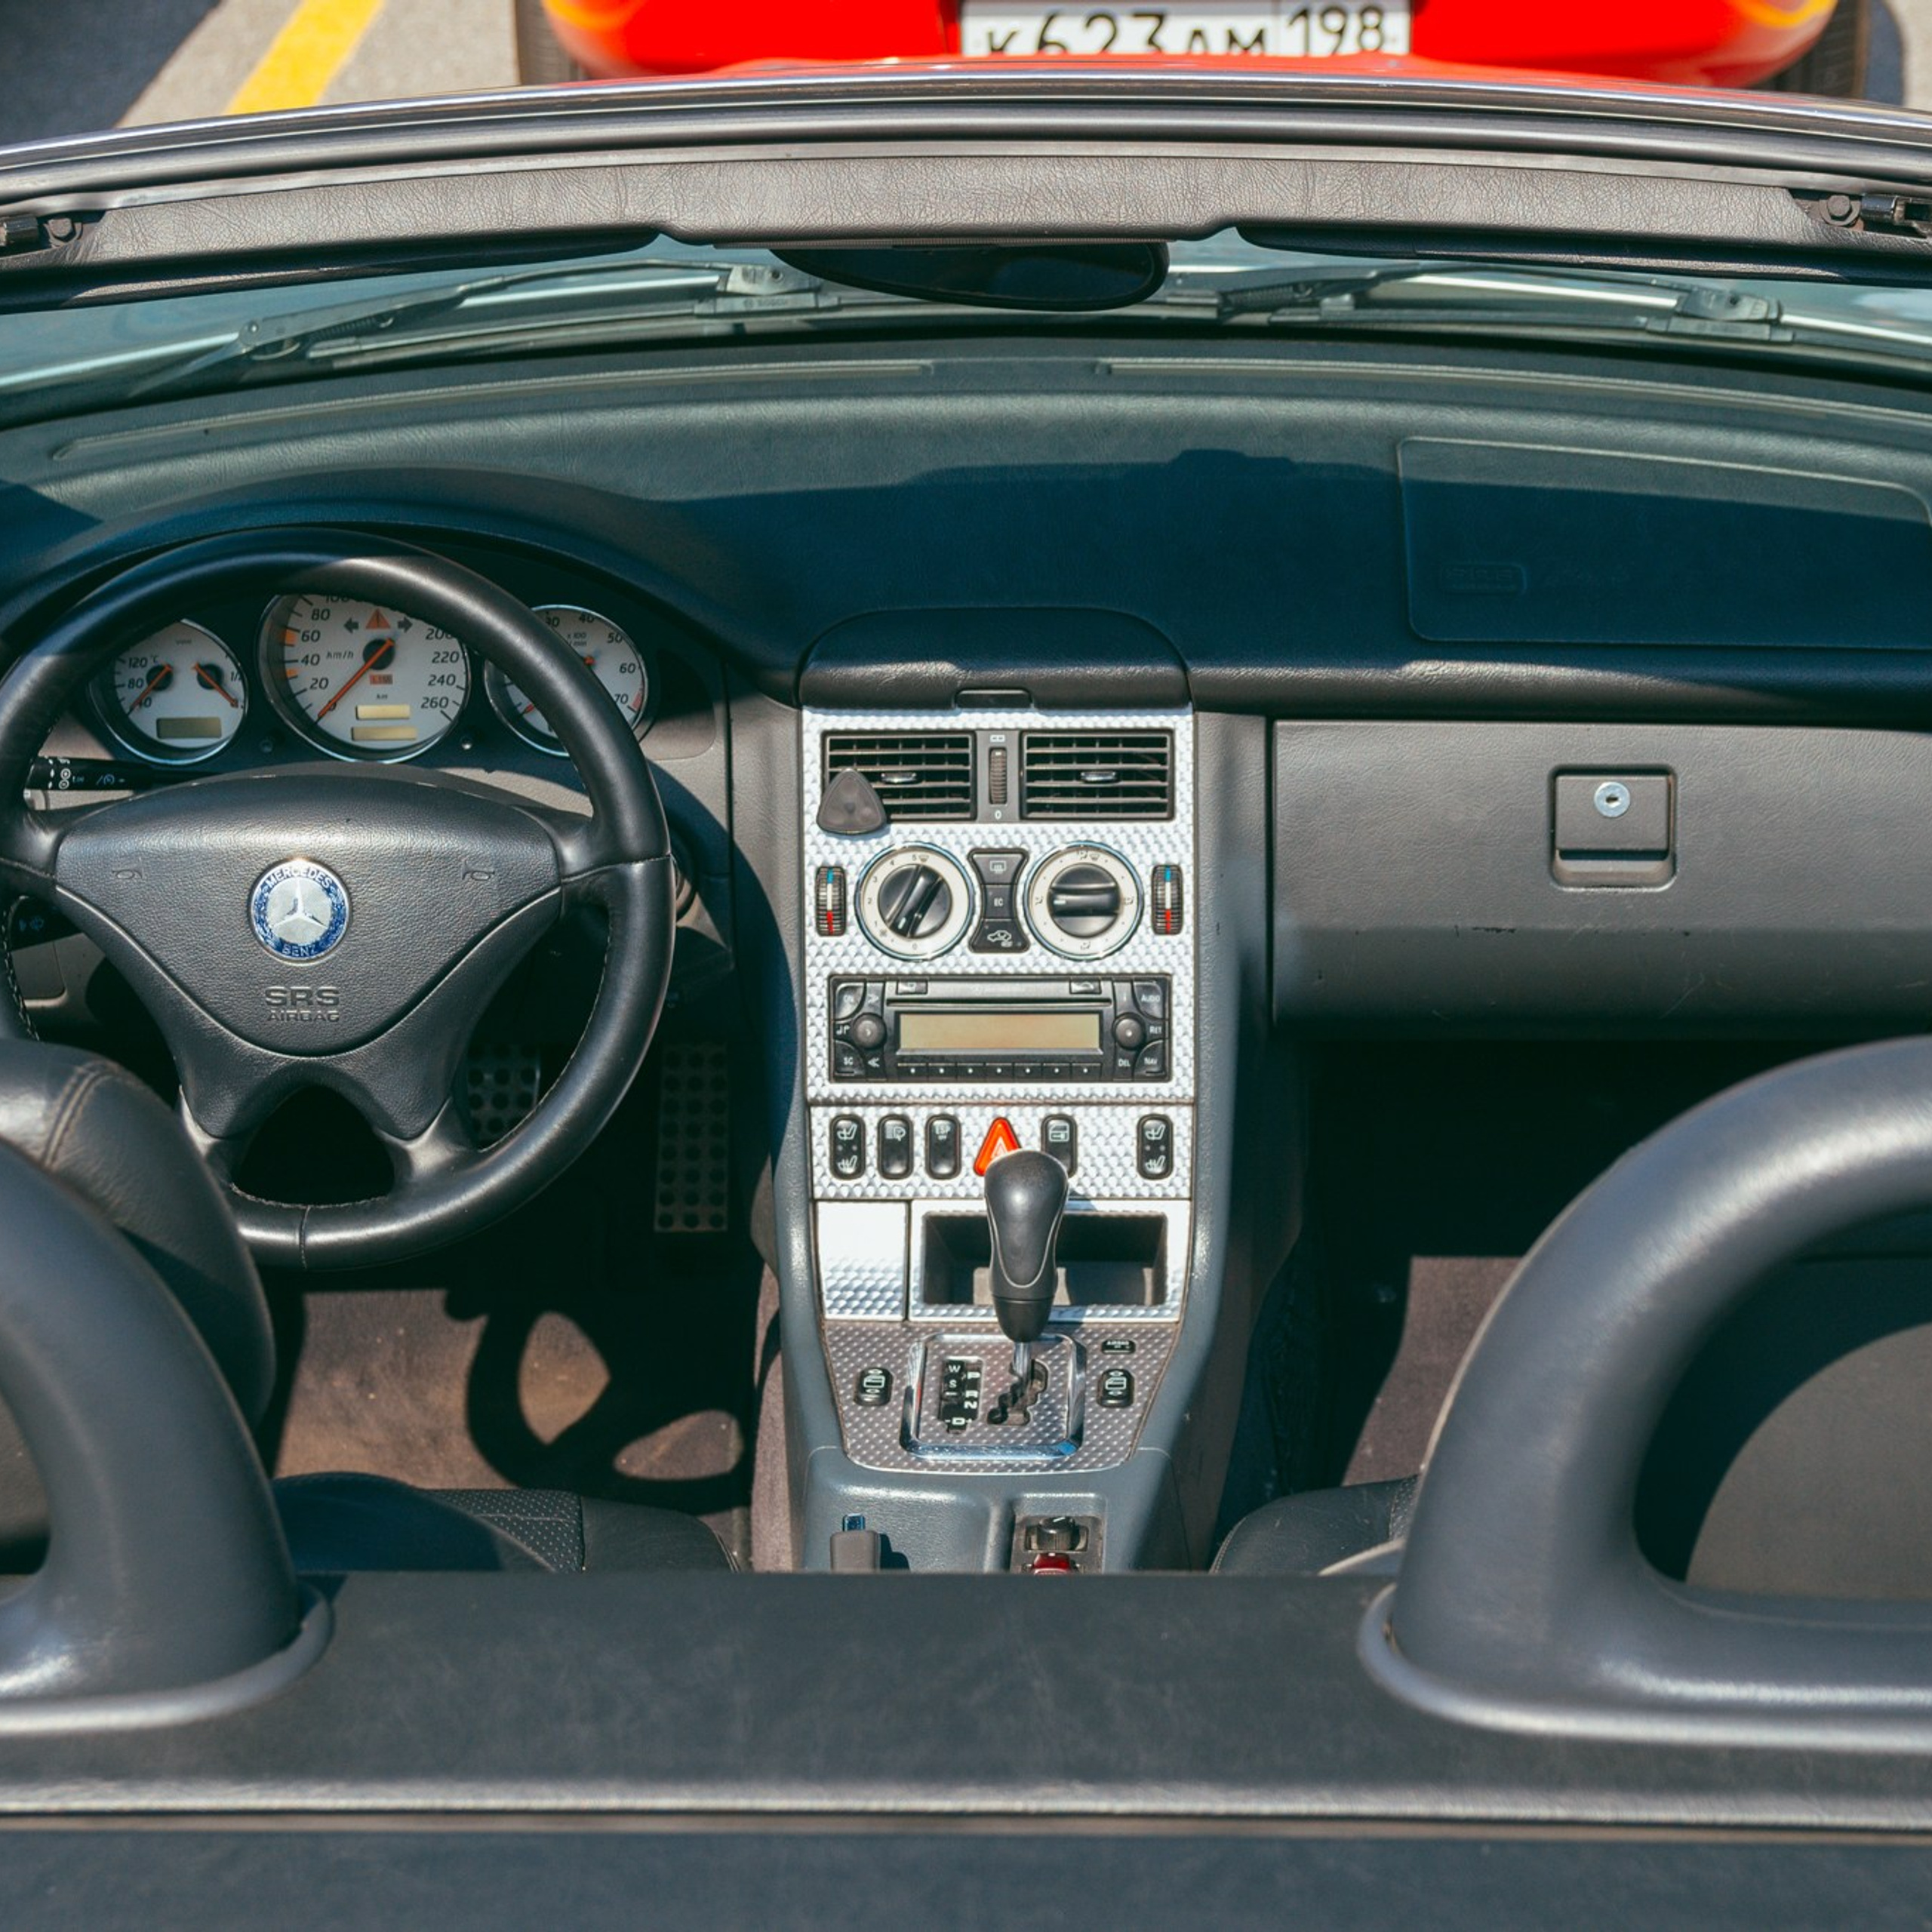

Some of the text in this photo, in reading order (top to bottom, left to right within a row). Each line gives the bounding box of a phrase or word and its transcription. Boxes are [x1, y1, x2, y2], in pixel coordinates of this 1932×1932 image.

[1287, 6, 1384, 56] 198
[311, 608, 331, 621] 80
[301, 629, 321, 642] 60
[607, 633, 623, 644] 50
[301, 654, 321, 666] 40
[325, 651, 354, 660] km/h
[431, 651, 460, 663] 220
[128, 657, 148, 669] 120
[619, 663, 635, 674] 60
[128, 678, 144, 689] 80
[309, 678, 329, 690] 20
[427, 674, 457, 686] 240
[420, 697, 449, 709] 260
[614, 694, 629, 704] 70
[994, 897, 1004, 907] EC
[282, 943, 318, 957] BENZ
[265, 986, 340, 1006] SRS
[266, 1010, 340, 1023] AIRBAG
[948, 1364, 961, 1373] W
[967, 1371, 981, 1380] P
[949, 1379, 958, 1389] S
[964, 1401, 977, 1410] N
